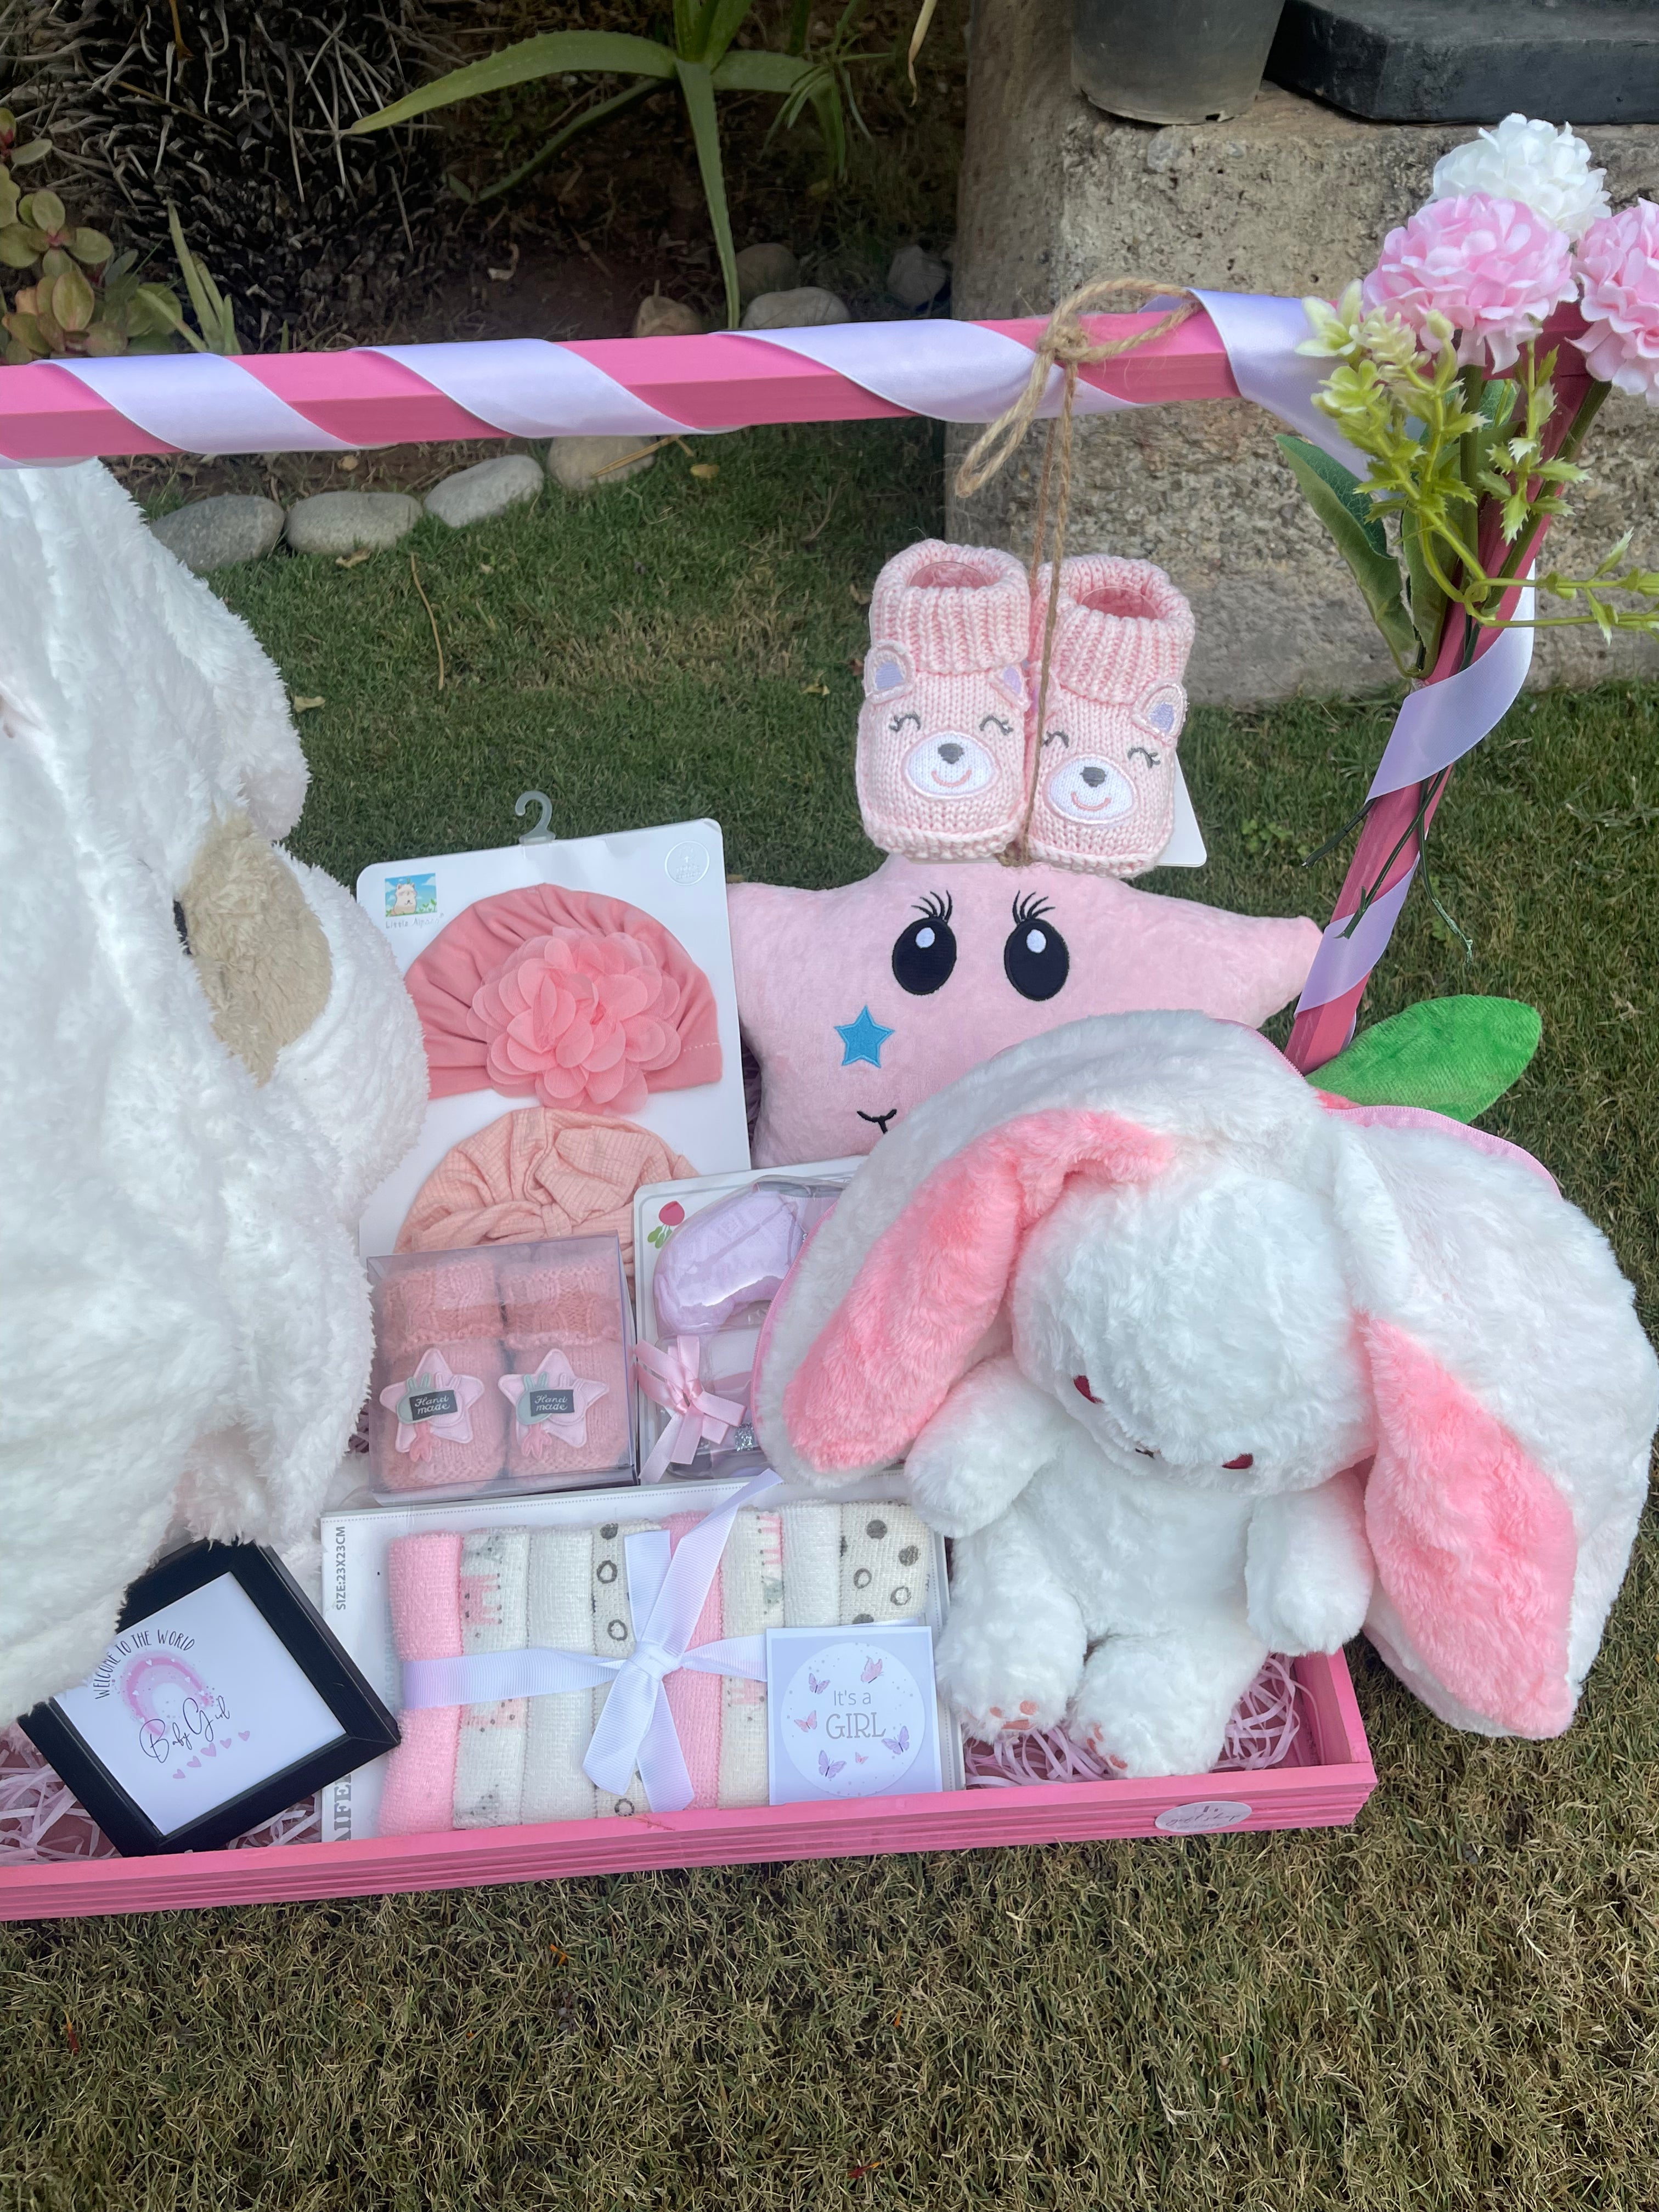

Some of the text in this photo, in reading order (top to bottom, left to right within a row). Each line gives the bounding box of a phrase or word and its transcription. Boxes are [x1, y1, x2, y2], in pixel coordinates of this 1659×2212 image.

[386, 919, 408, 929] Little
[414, 1395, 450, 1407] Hand
[534, 1395, 568, 1406] Hand
[535, 1403, 568, 1411] made
[417, 1404, 450, 1415] made
[336, 1526, 346, 1610] SIZE:23X23CM
[93, 1629, 195, 1700] WELCOME TO THE WORLD
[834, 1690, 871, 1706] It's a
[826, 1712, 887, 1740] GIRL
[139, 1719, 192, 1763] Baby
